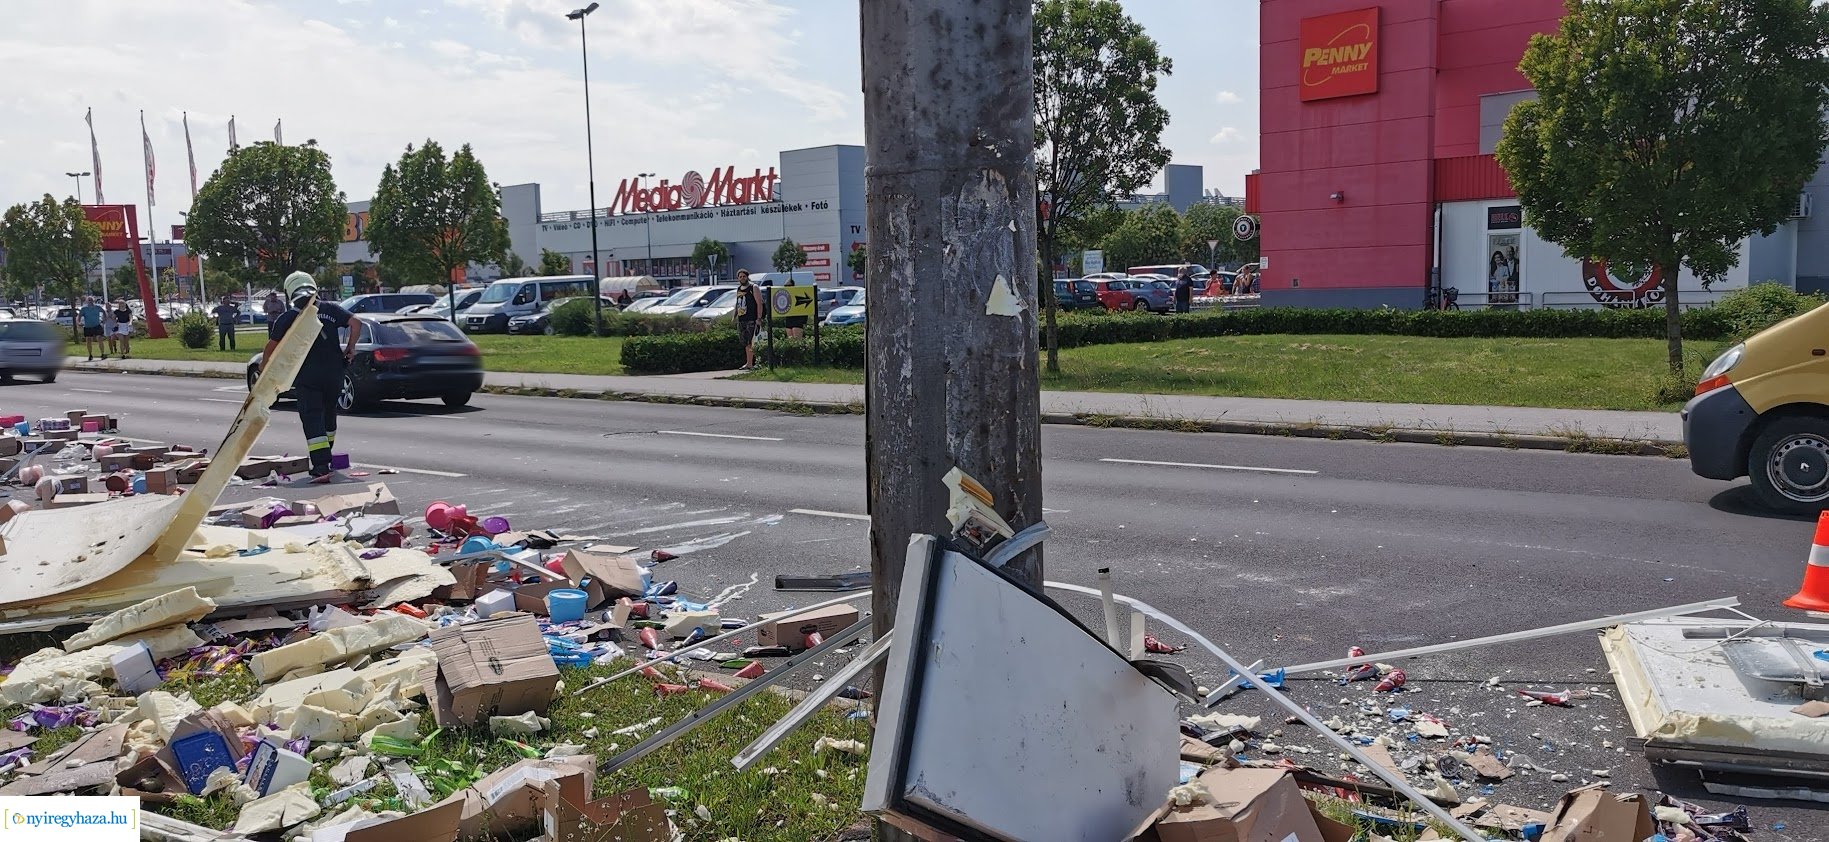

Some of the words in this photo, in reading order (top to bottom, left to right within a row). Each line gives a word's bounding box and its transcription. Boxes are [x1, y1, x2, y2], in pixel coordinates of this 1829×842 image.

[1303, 41, 1373, 67] PENNY
[1331, 63, 1368, 75] MARKET
[608, 178, 683, 216] Media
[700, 166, 778, 207] Markt
[542, 224, 548, 232] TV
[586, 221, 598, 229] DD
[655, 211, 714, 223] Telekommunikáció
[720, 205, 757, 218] Háztartási
[760, 203, 802, 215] készülékek
[810, 200, 828, 211] Fotó
[850, 225, 861, 234] TV
